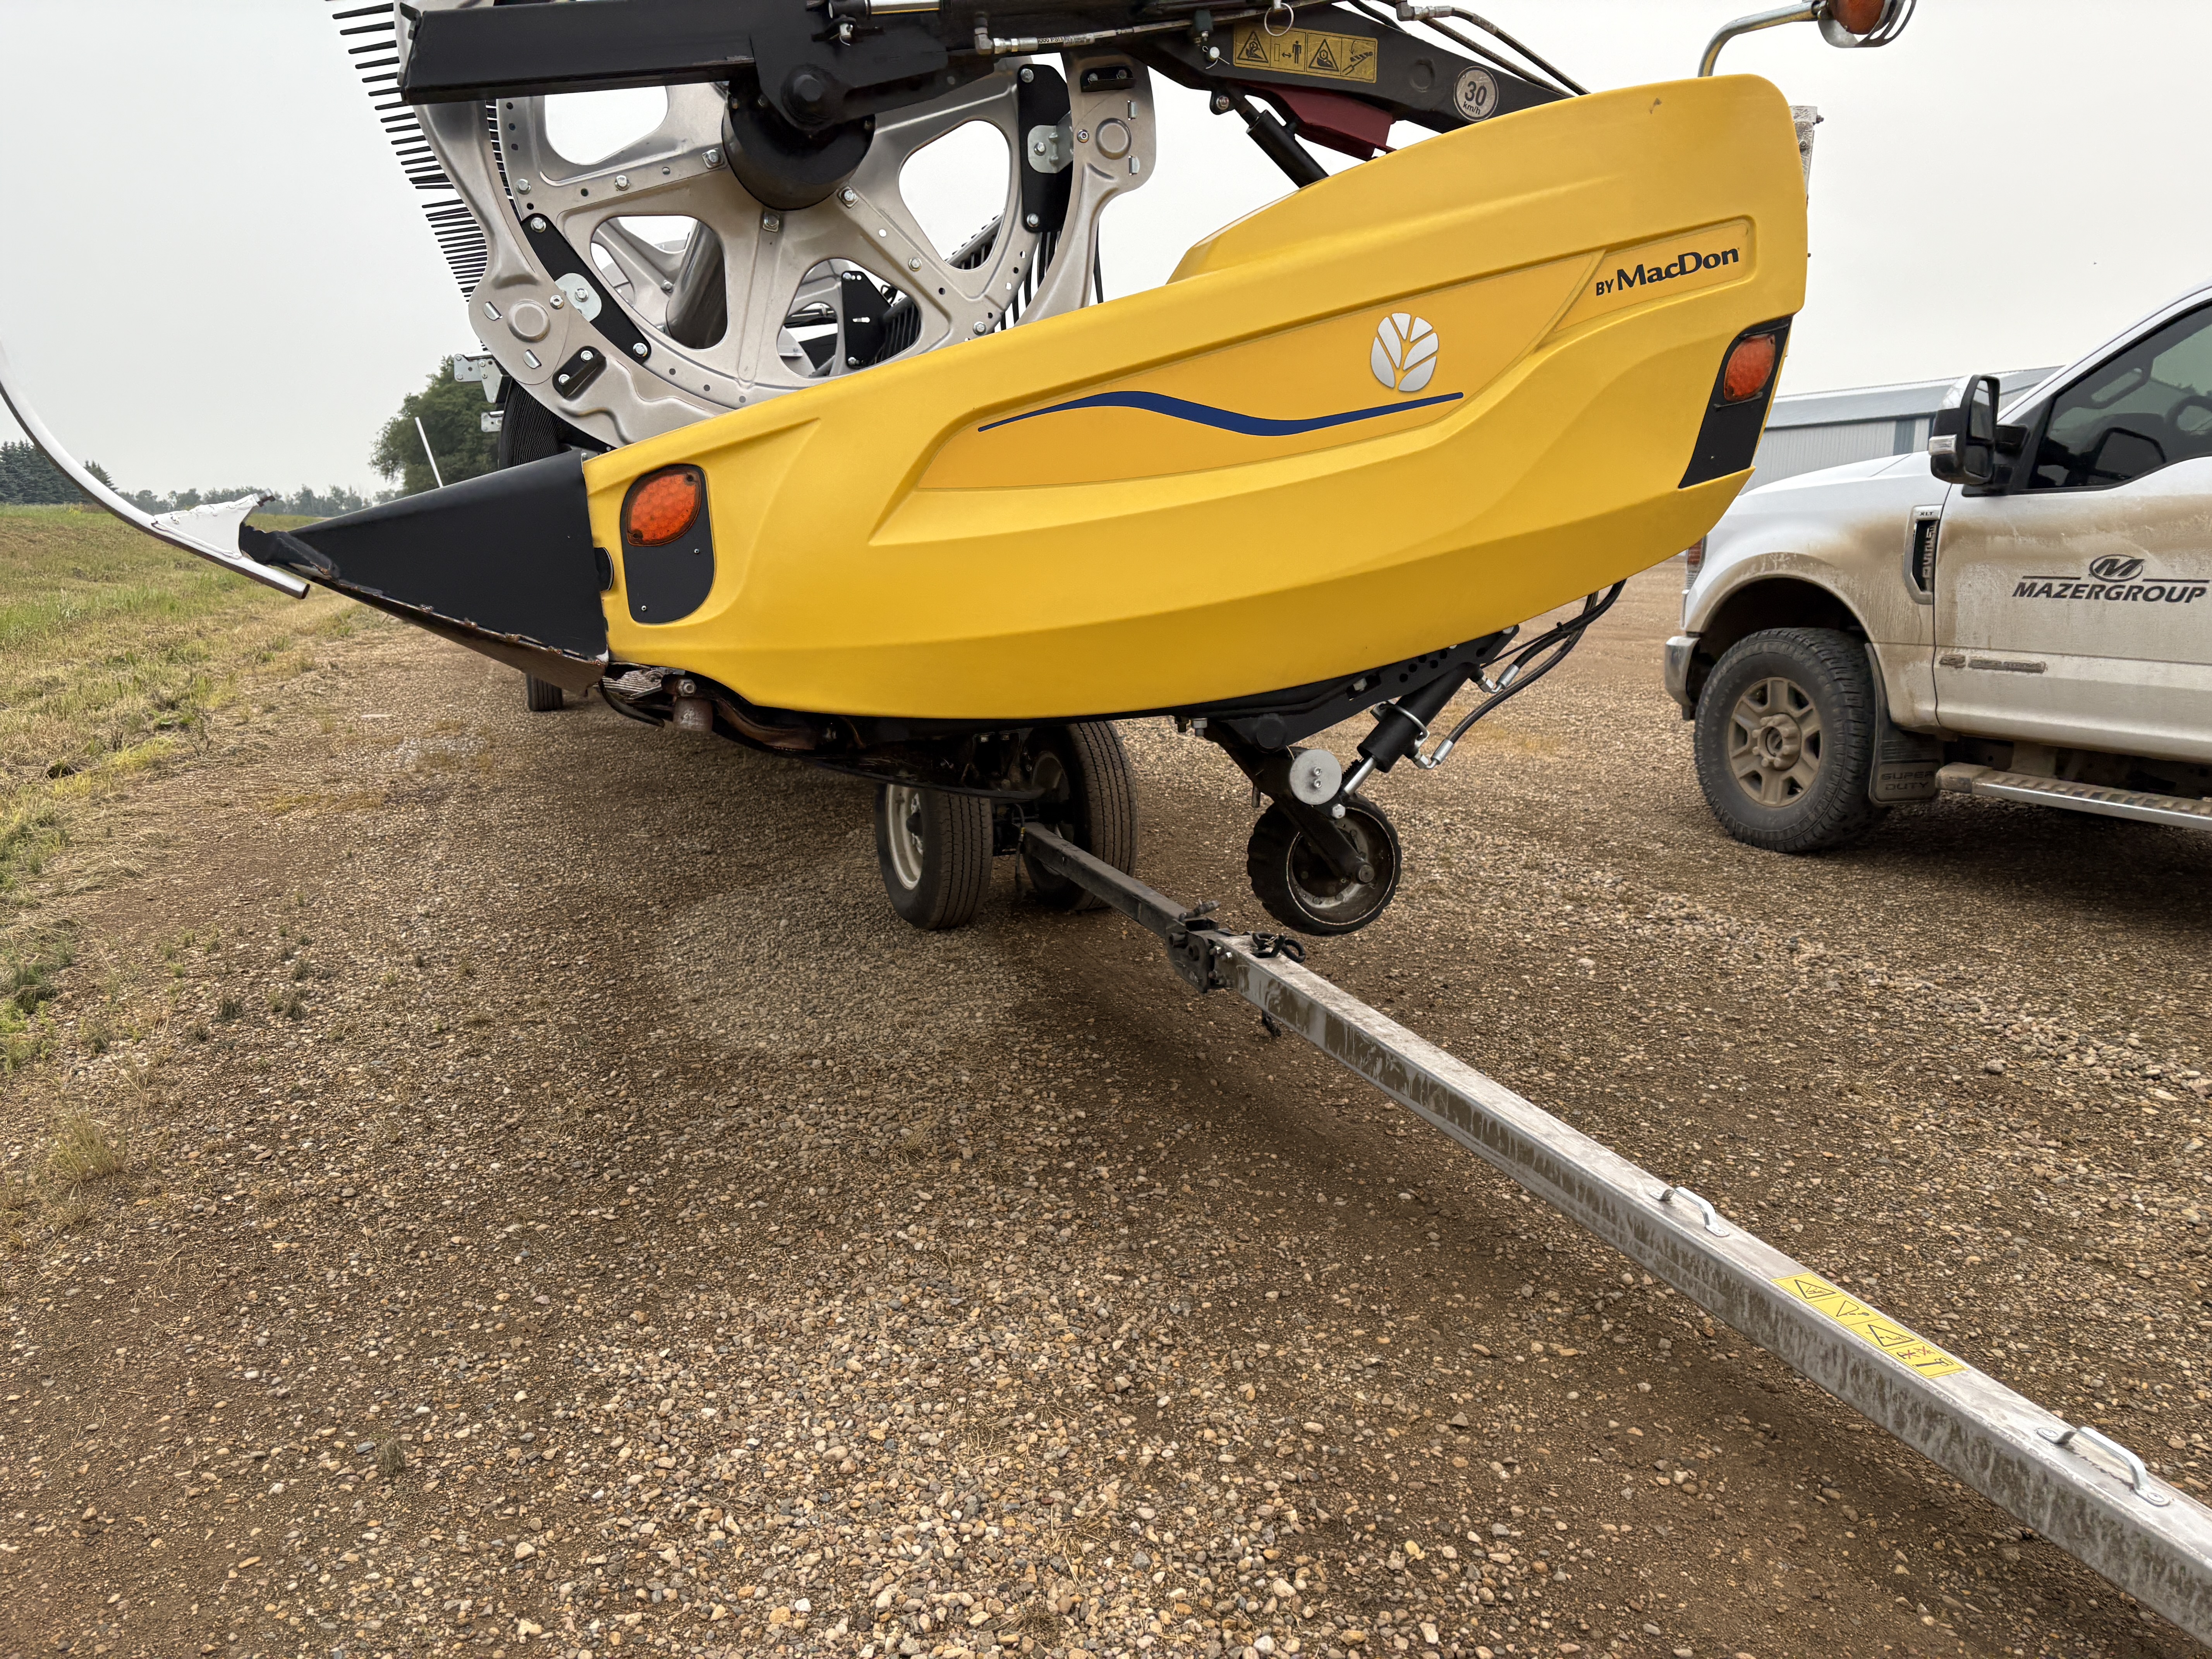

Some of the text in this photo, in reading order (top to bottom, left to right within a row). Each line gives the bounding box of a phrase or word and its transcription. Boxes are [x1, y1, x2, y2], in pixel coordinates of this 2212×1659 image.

[1465, 81, 1487, 106] 30
[1463, 101, 1480, 115] km/h
[1596, 248, 1739, 296] BY MacDon
[2012, 582, 2207, 603] MAZERGROUP
[1886, 782, 1929, 790] DUTY
